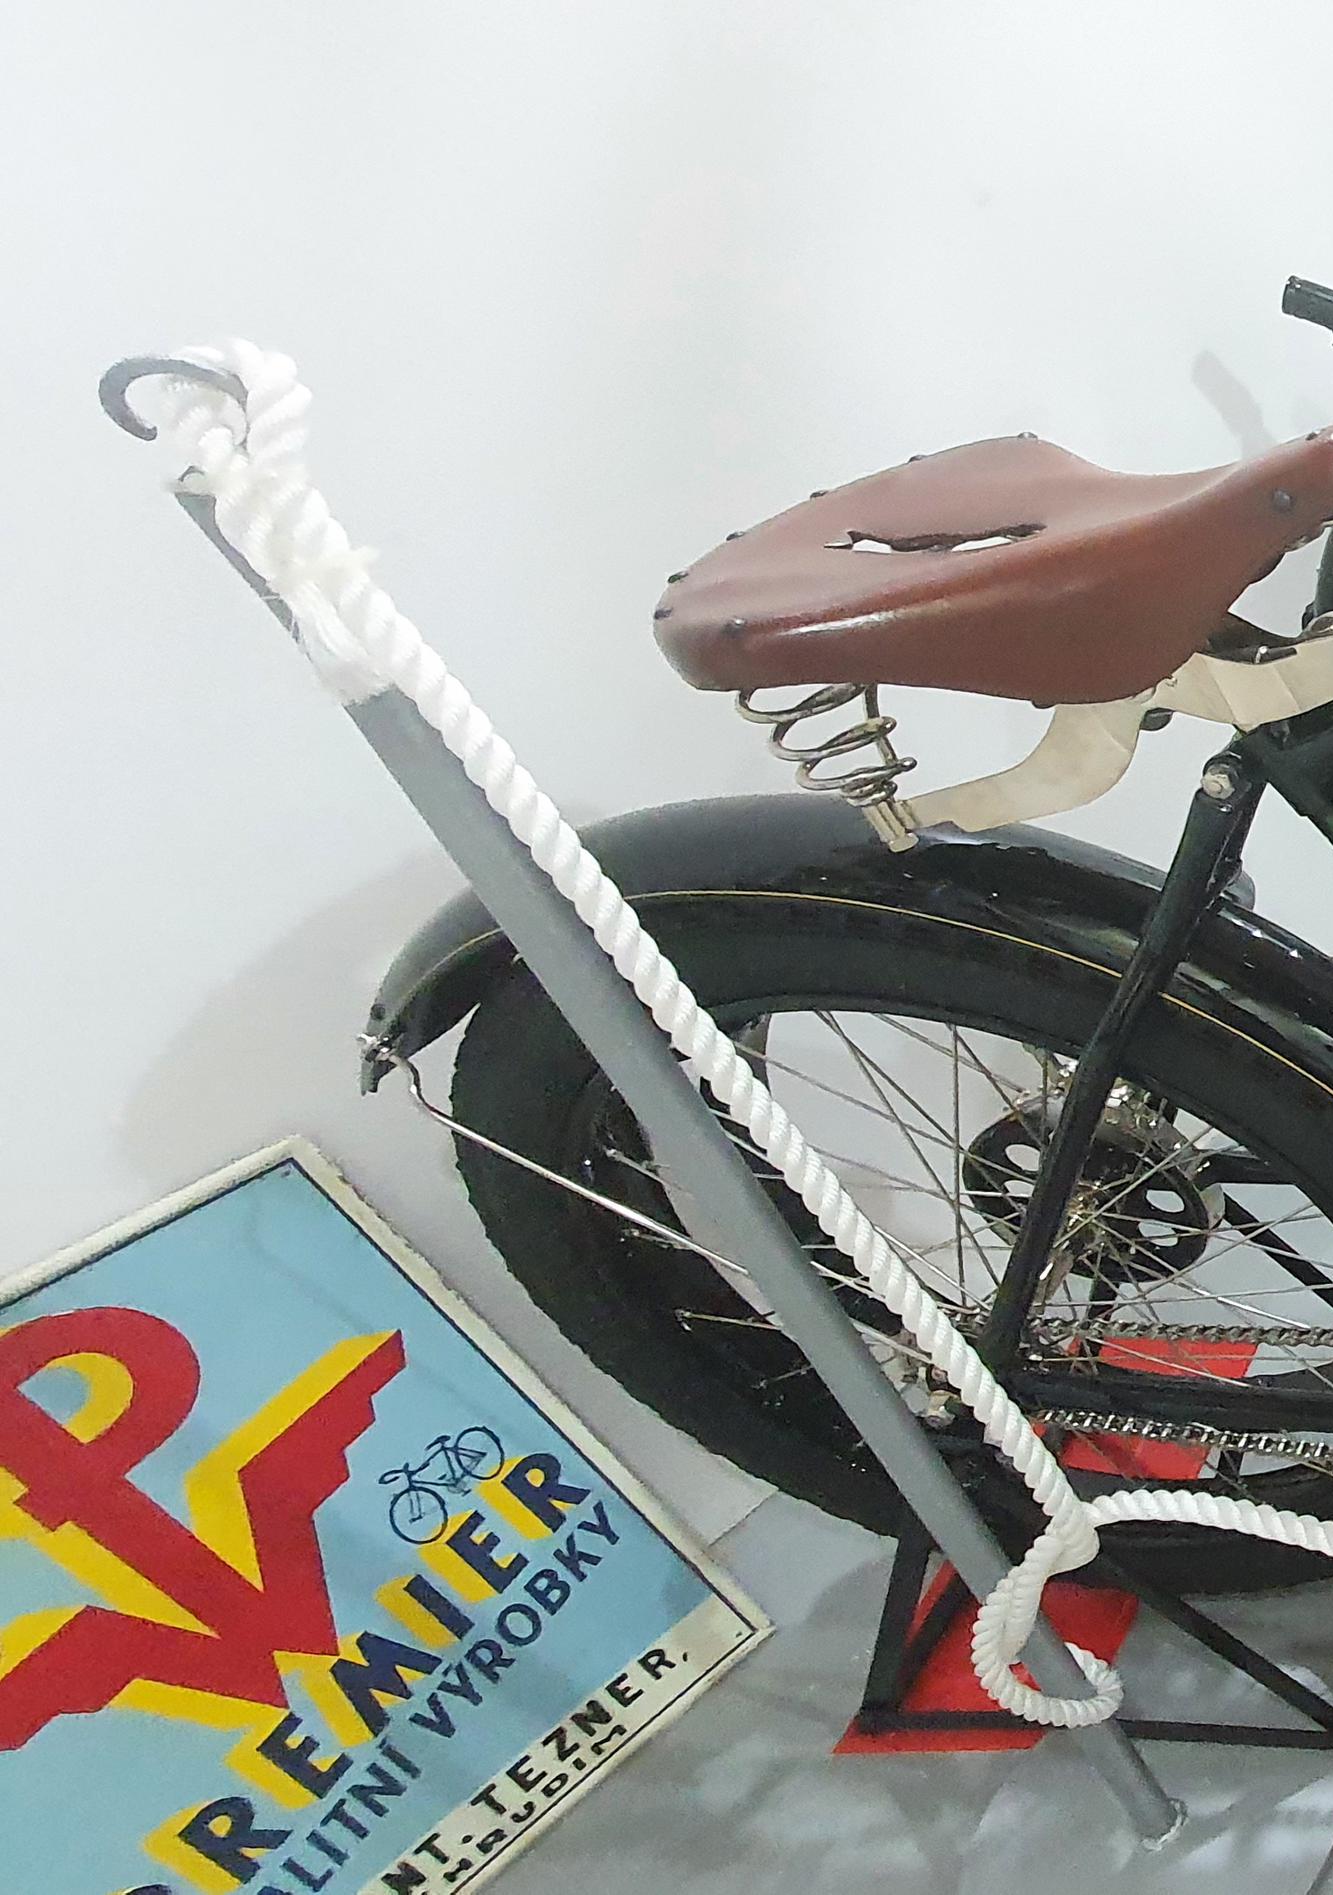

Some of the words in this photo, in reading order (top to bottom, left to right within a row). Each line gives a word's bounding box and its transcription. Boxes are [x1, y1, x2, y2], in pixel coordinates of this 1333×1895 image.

[124, 1453, 591, 1895] REMIER
[257, 1738, 421, 1895] LITNÍ
[409, 1500, 619, 1738] VÝROBKY
[420, 1724, 627, 1895] HRUDIM
